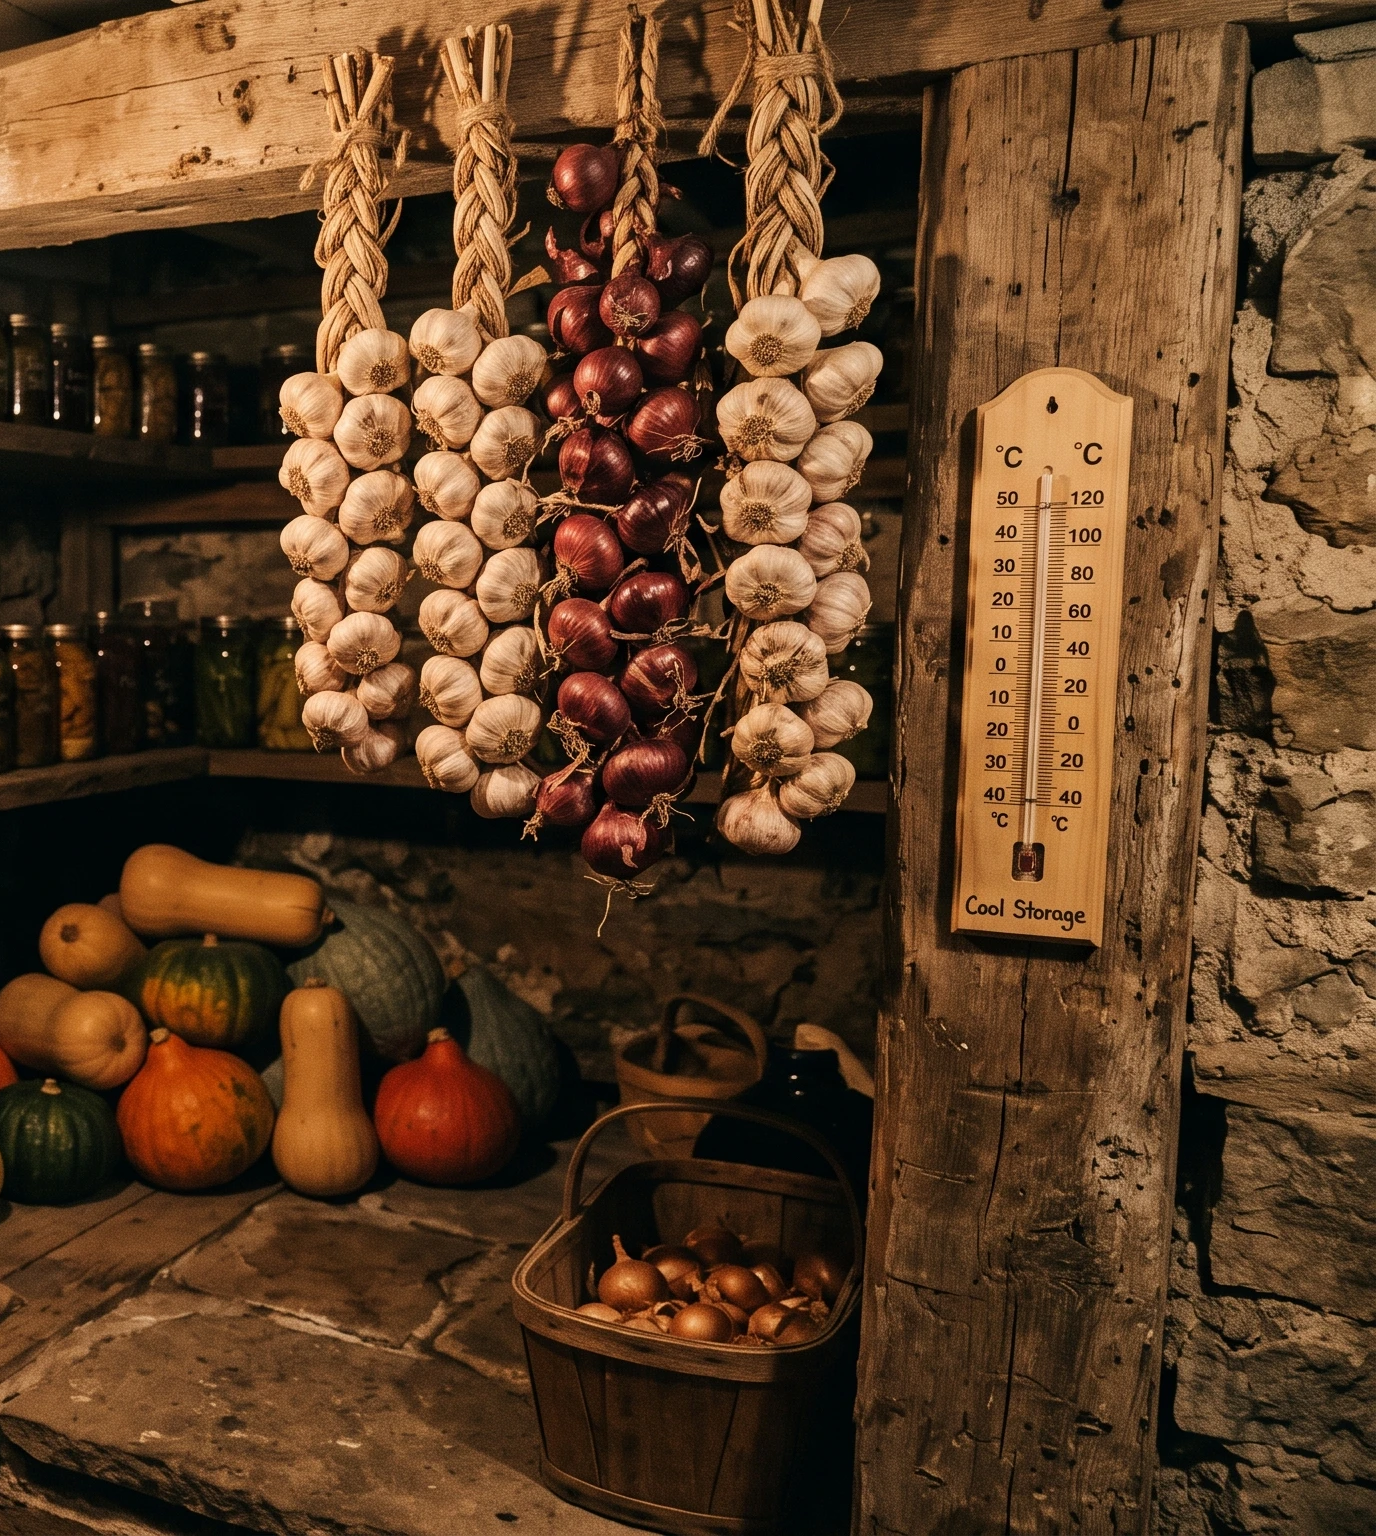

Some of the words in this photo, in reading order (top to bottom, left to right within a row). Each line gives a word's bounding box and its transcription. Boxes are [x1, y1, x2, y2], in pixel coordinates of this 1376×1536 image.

[996, 491, 1019, 505] 50
[1070, 490, 1104, 505] 120
[995, 525, 1017, 539] 40
[1069, 528, 1102, 543] 100
[994, 559, 1015, 573] 30
[1070, 566, 1093, 581] 80
[992, 592, 1014, 606] 20
[1068, 604, 1091, 618] 60
[991, 625, 1012, 639] 10
[1066, 642, 1089, 656] 40
[995, 658, 1006, 671] 0
[1064, 679, 1087, 693] 20
[989, 690, 1009, 704] 10
[986, 722, 1008, 737] 20
[1068, 716, 1079, 730] 0
[985, 754, 1007, 769] 30
[1060, 753, 1084, 768] 20
[984, 787, 1005, 801] 40
[1059, 790, 1082, 805] 40
[966, 895, 1004, 917] Cool
[1013, 899, 1086, 932] Storage
